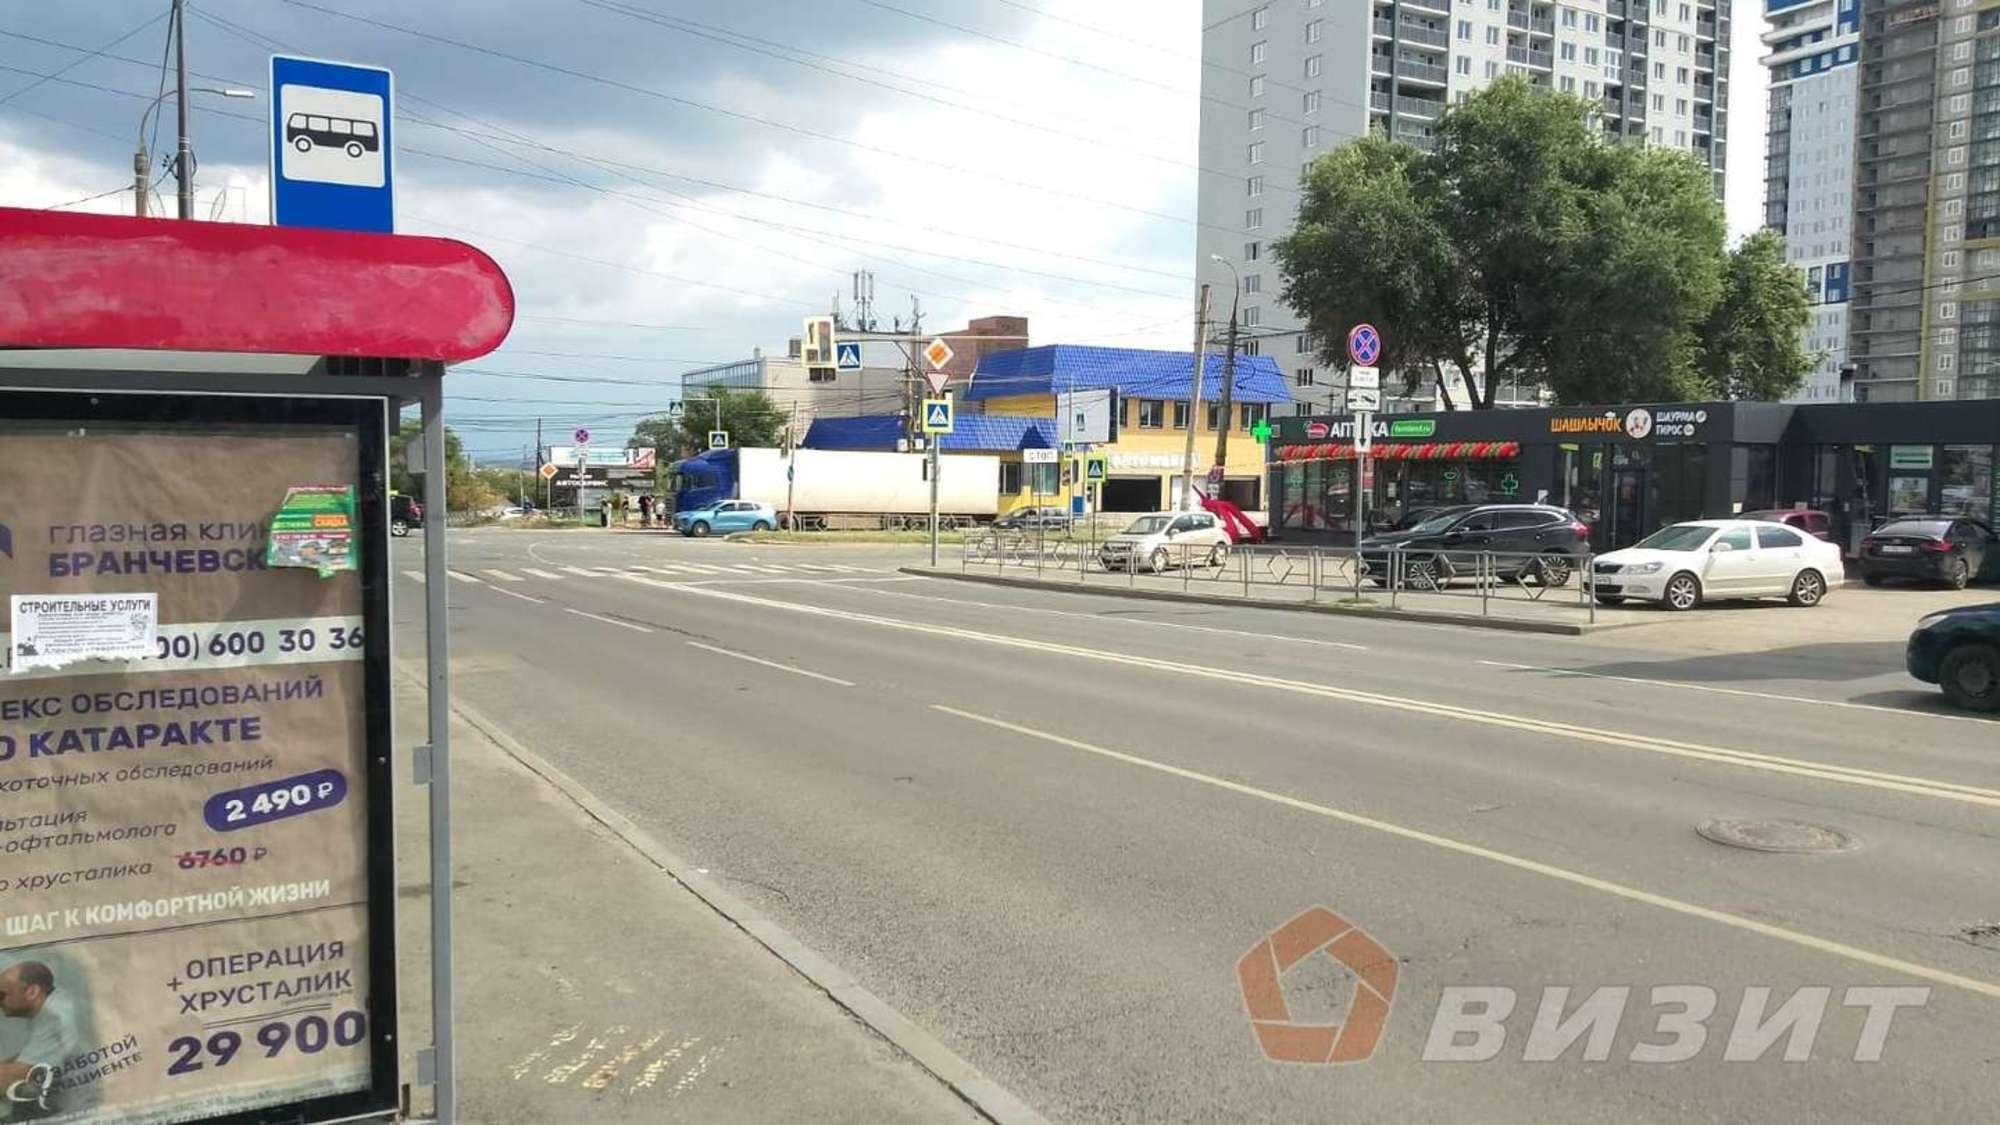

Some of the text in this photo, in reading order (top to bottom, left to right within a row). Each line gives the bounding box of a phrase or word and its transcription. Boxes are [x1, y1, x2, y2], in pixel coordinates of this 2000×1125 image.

[1329, 421, 1389, 438] АПТКА
[1551, 416, 1623, 433] ШАШЛЫЧОК
[1656, 411, 1695, 422] ШАУРМА
[1656, 424, 1683, 435] ГИРОС
[49, 522, 187, 544] глазная
[49, 547, 269, 577] БРАНЧЕВСК
[20, 599, 151, 614] СТРОИТЕЛЬНЫЕ УСЛУГИ
[208, 631, 265, 657] 600
[278, 629, 316, 651] 30
[329, 626, 364, 649] 36
[71, 674, 323, 713] ОБСЛЕДОВАНИЙ
[29, 716, 262, 758] КАТАРАКТЕ
[115, 755, 274, 782] обследований
[225, 799, 247, 822] 2
[251, 784, 311, 814] 490
[177, 846, 247, 869] 6760
[15, 861, 153, 891] хрусталика
[5, 880, 330, 936] ШАГ К КОМФОРТНОЙ ЖИЗНИ
[186, 940, 345, 980] ОПЕРАЦИЯ
[179, 968, 352, 1015] ХРУСТАЛИК
[167, 1010, 366, 1076] 29 900
